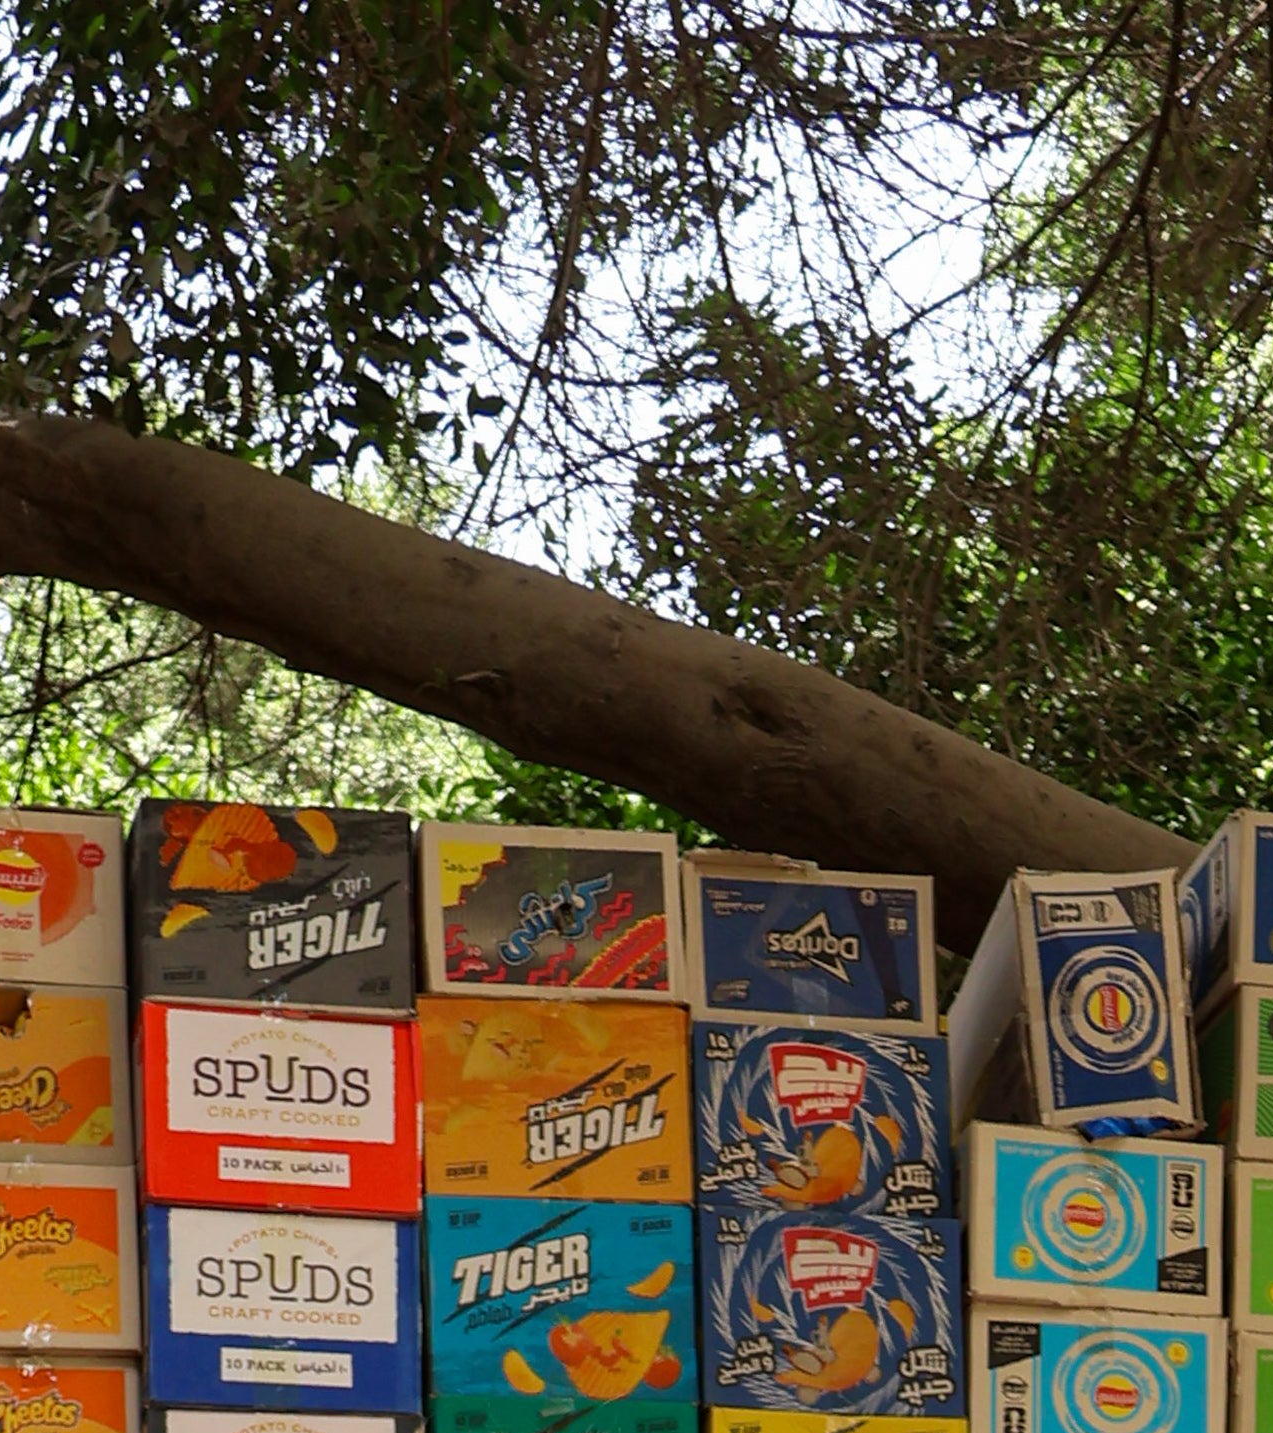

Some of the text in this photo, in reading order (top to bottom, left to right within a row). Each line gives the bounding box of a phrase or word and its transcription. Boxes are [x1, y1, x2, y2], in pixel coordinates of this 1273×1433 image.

[249, 902, 386, 970] TIGER
[768, 934, 860, 962] Doritos
[192, 1053, 371, 1107] SPUDS
[207, 1105, 360, 1127] CRAFT COOKED
[528, 1094, 667, 1165] TIGER
[246, 1158, 283, 1172] PACK
[232, 1228, 287, 1247] POTATO
[196, 1253, 374, 1306] SPUDS
[453, 1233, 590, 1306] TIGER
[208, 1306, 361, 1326] CRAFT COOKED
